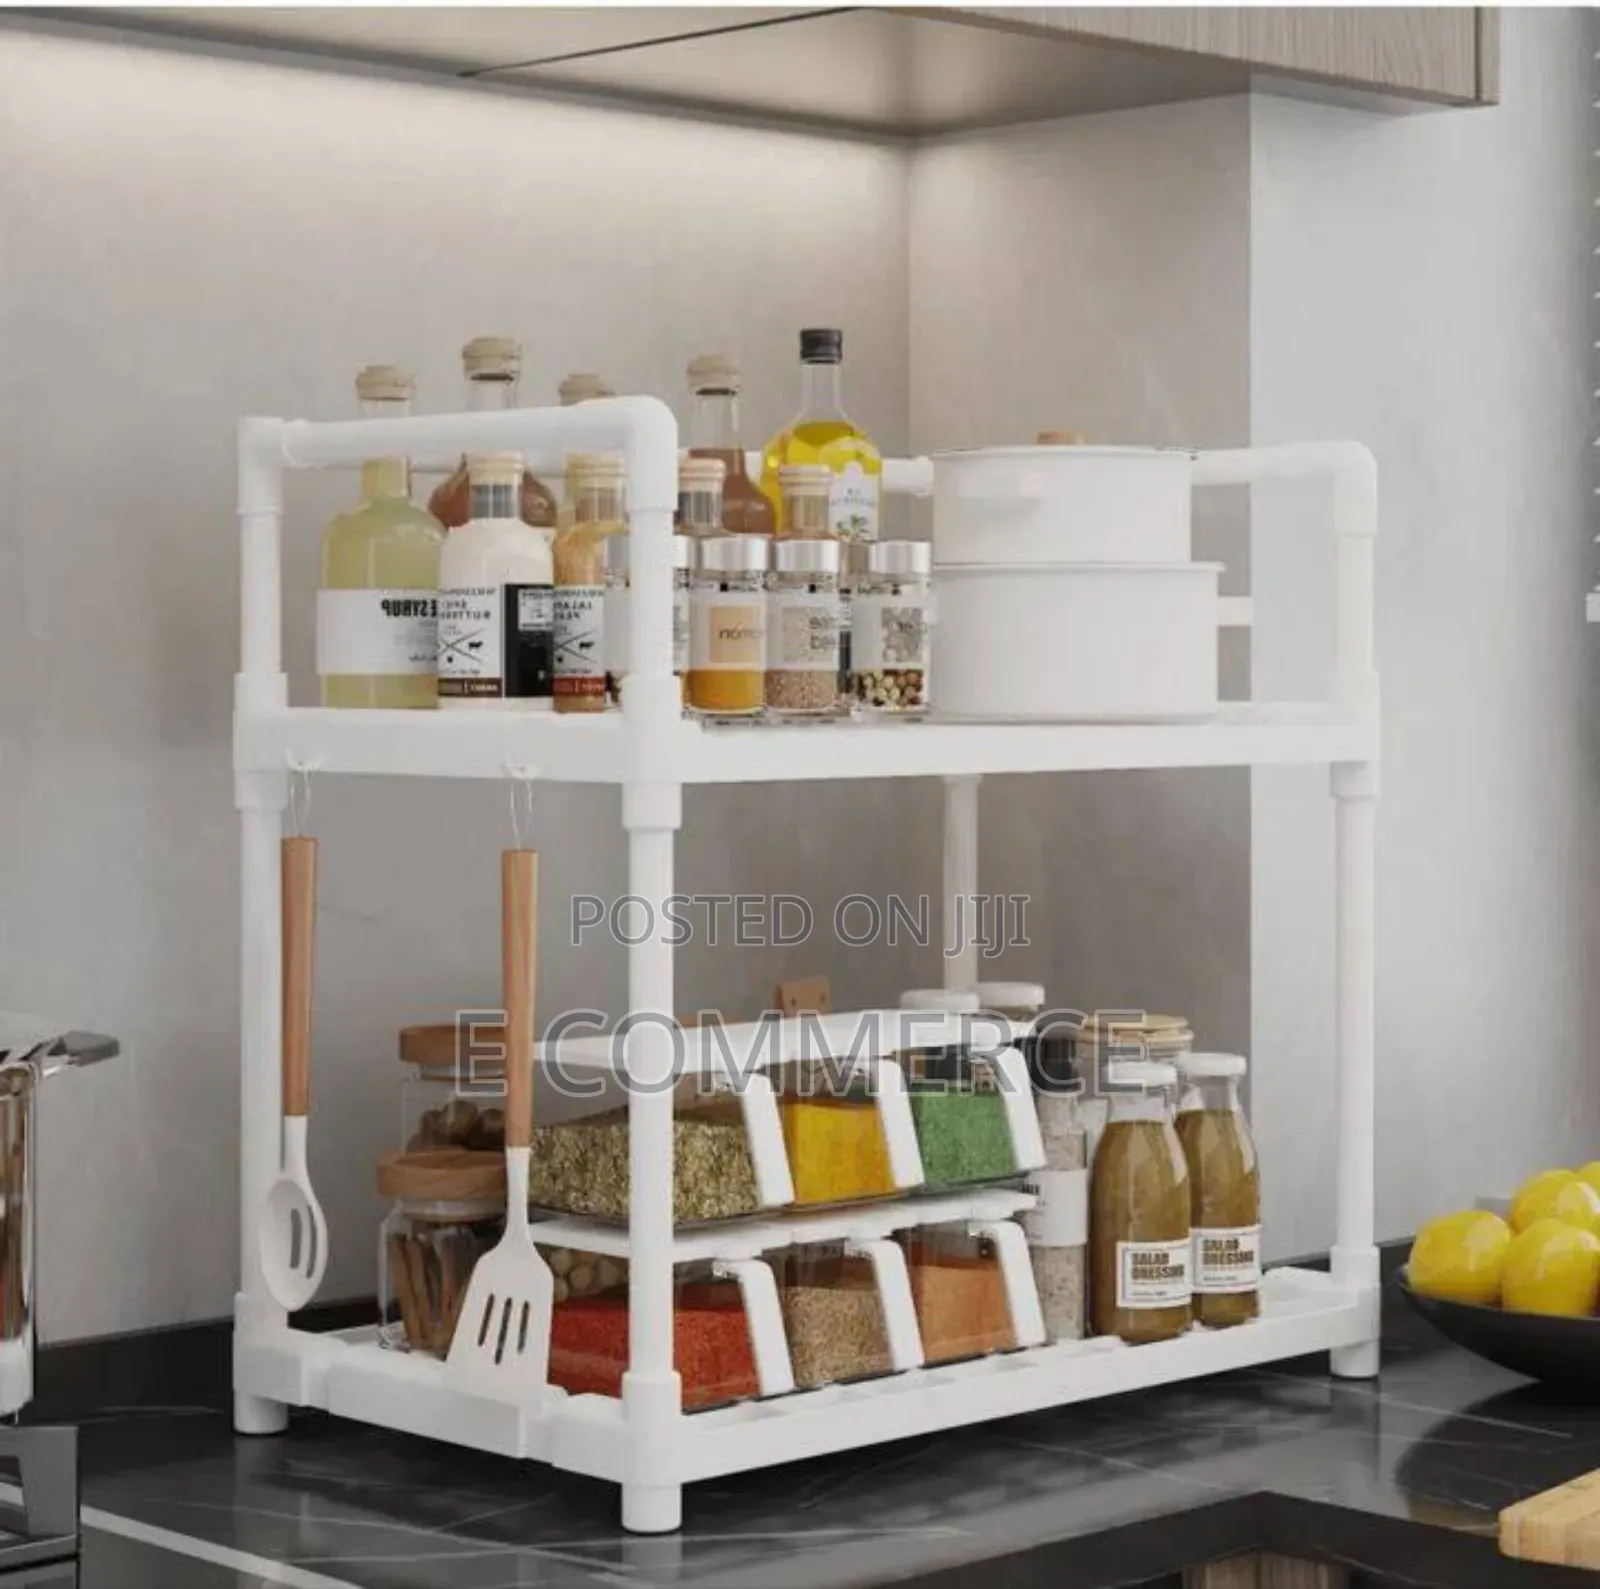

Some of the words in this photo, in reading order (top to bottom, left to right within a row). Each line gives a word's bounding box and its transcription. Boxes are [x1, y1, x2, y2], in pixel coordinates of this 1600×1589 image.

[1203, 1239, 1239, 1251] SALAD
[1132, 1252, 1169, 1266] SALAD
[1203, 1251, 1254, 1266] DRESSING
[1132, 1265, 1185, 1280] DRESSING
